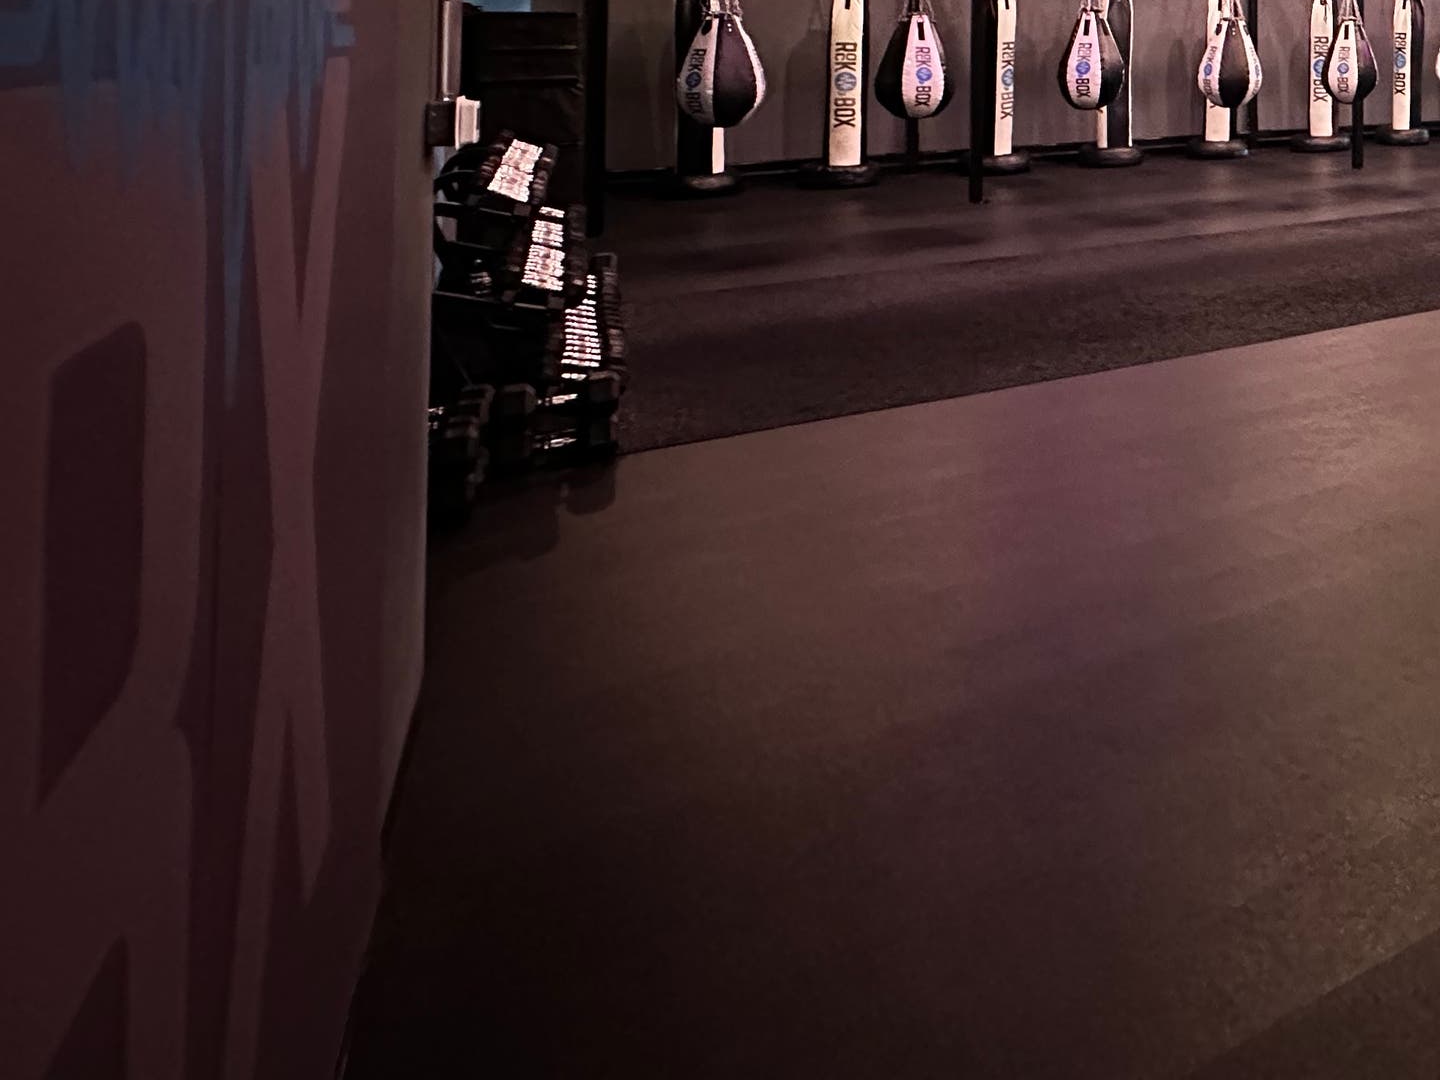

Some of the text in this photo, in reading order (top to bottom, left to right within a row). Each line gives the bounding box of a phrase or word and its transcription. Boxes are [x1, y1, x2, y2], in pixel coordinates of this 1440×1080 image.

[914, 86, 932, 107] BOX
[1076, 78, 1091, 98] BOX
[834, 97, 856, 128] BOX
